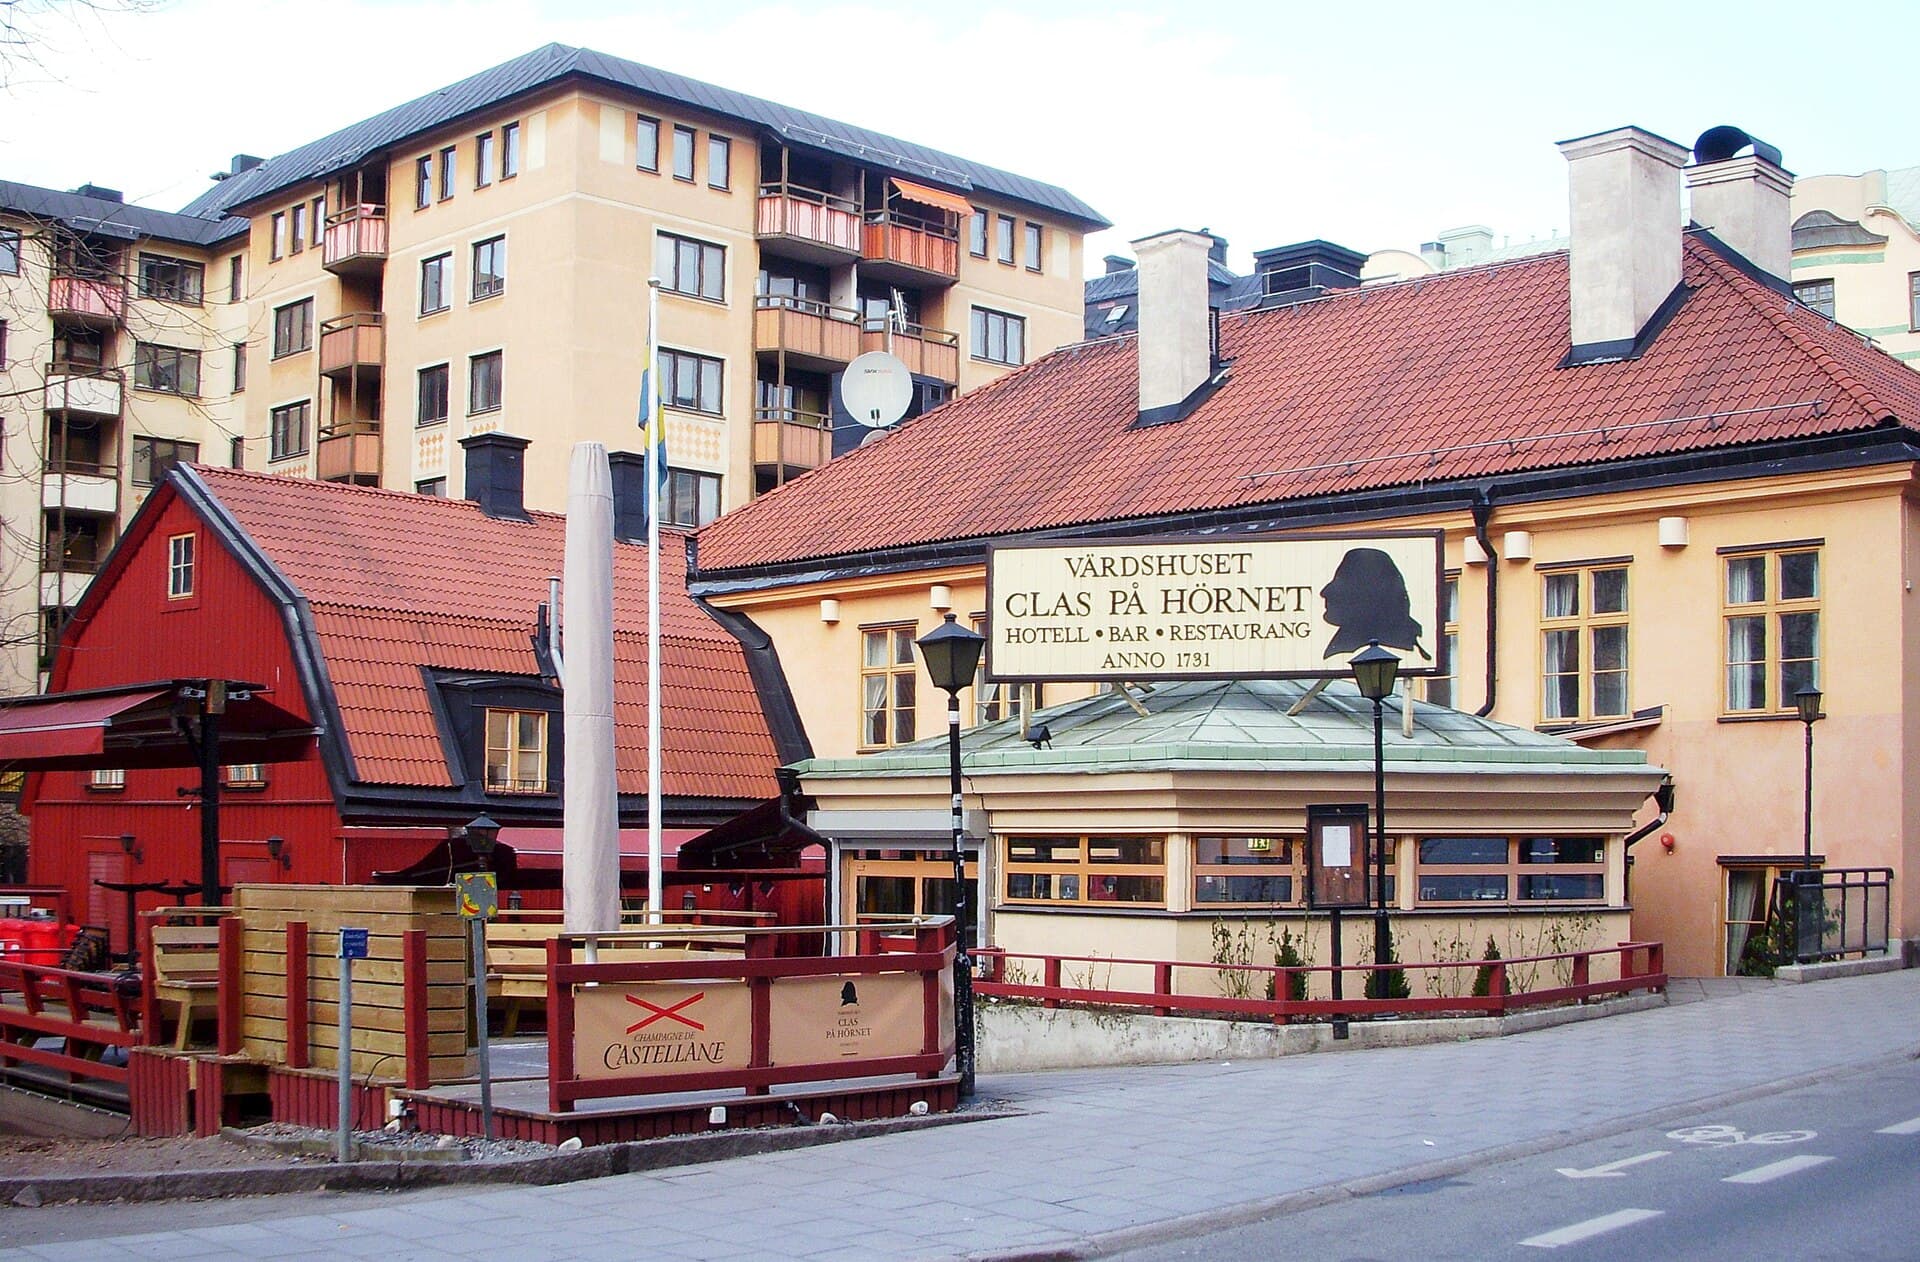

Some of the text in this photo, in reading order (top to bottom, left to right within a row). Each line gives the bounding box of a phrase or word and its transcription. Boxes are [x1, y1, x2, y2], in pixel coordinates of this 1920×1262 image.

[1064, 551, 1253, 578] VÄRDSHUSET
[1005, 581, 1313, 618] CLAS PÅ HÖRNET
[1005, 621, 1312, 644] HOTELL BAR RESTAURANG
[1100, 651, 1211, 670] ANNO 1731
[838, 1018, 859, 1027] CLAS
[633, 1031, 696, 1043] CHAMPAGNE DE
[825, 1028, 872, 1039] PÅ HÖRNET
[603, 1041, 726, 1070] CASTELLANE
